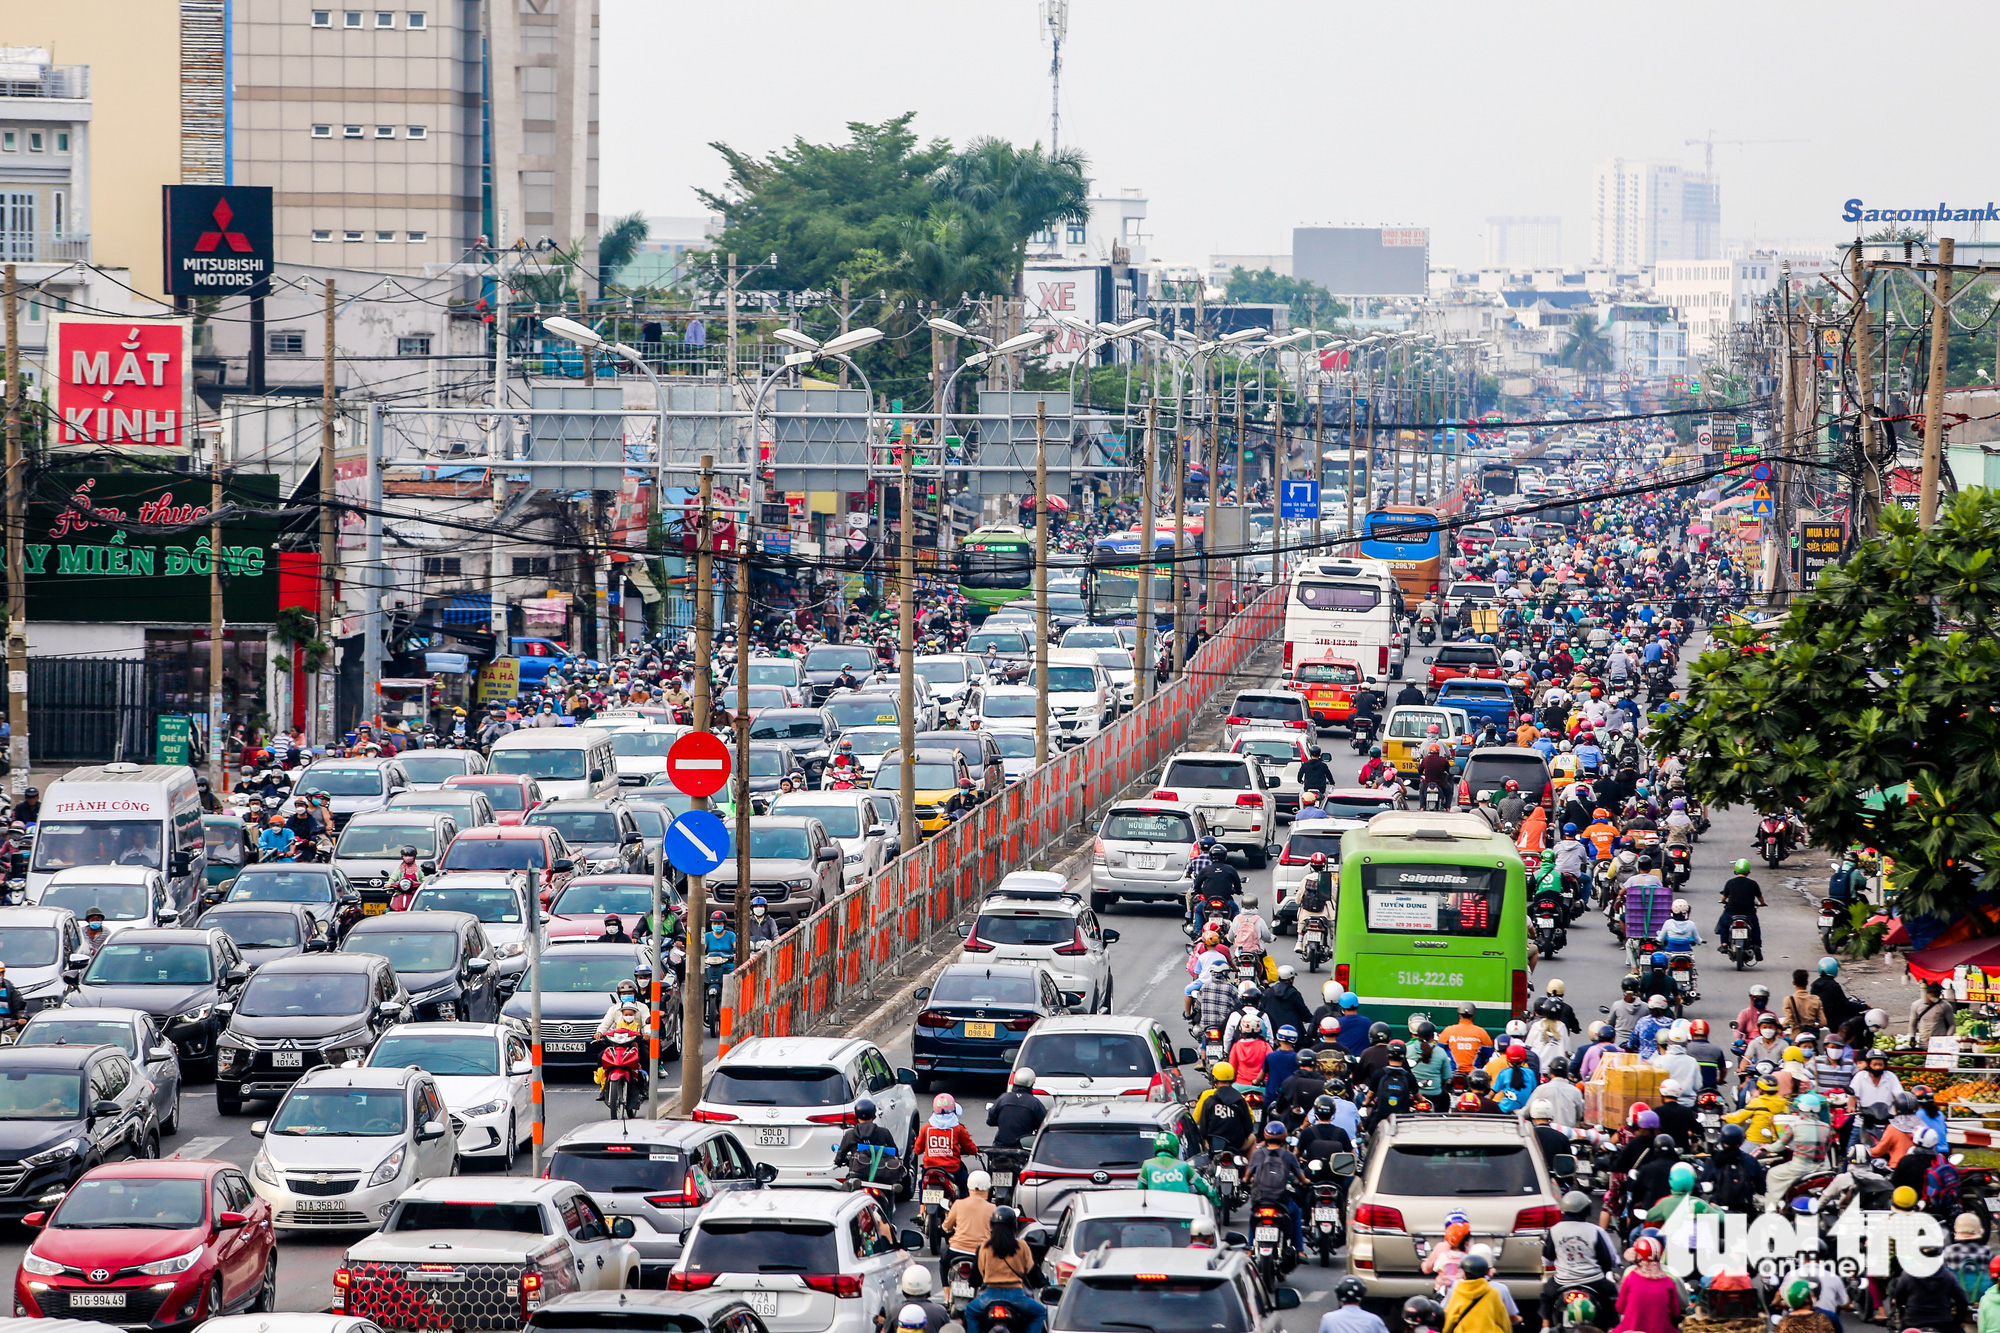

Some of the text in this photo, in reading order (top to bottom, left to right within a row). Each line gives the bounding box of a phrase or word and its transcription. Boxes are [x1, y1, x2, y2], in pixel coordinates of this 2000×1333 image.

[1842, 198, 2000, 223] Sacombank
[183, 258, 264, 271] MITSUBISHI
[194, 272, 254, 286] MOTORS
[1037, 282, 1076, 311] XE
[72, 327, 170, 387] MẮT
[65, 390, 176, 444] KÍNH
[1806, 526, 1840, 538] MUA BÁN
[57, 528, 157, 575] MIỀN
[1806, 539, 1820, 552] SỬA
[1821, 540, 1839, 552] CHỮA
[1806, 556, 1824, 567] iPhone
[499, 670, 515, 681] HÀ
[160, 732, 186, 743] ĐIỂM
[1402, 762, 1419, 770] 51D-3
[56, 799, 150, 813] THÀNH CÔNG
[1398, 873, 1468, 884] SaigonBus
[1460, 899, 1488, 927] 91
[1414, 940, 1448, 949] SAMCO
[1398, 970, 1464, 987] 51B-222.66
[968, 1029, 994, 1037] 098.94
[281, 1052, 294, 1060] 51K
[276, 1059, 300, 1067] 101.45
[760, 1136, 785, 1144] 197.12
[929, 1135, 949, 1149] GO!
[1151, 1168, 1183, 1183] Grab
[72, 1295, 124, 1306] 51G-994.49
[751, 1292, 769, 1303] 72A
